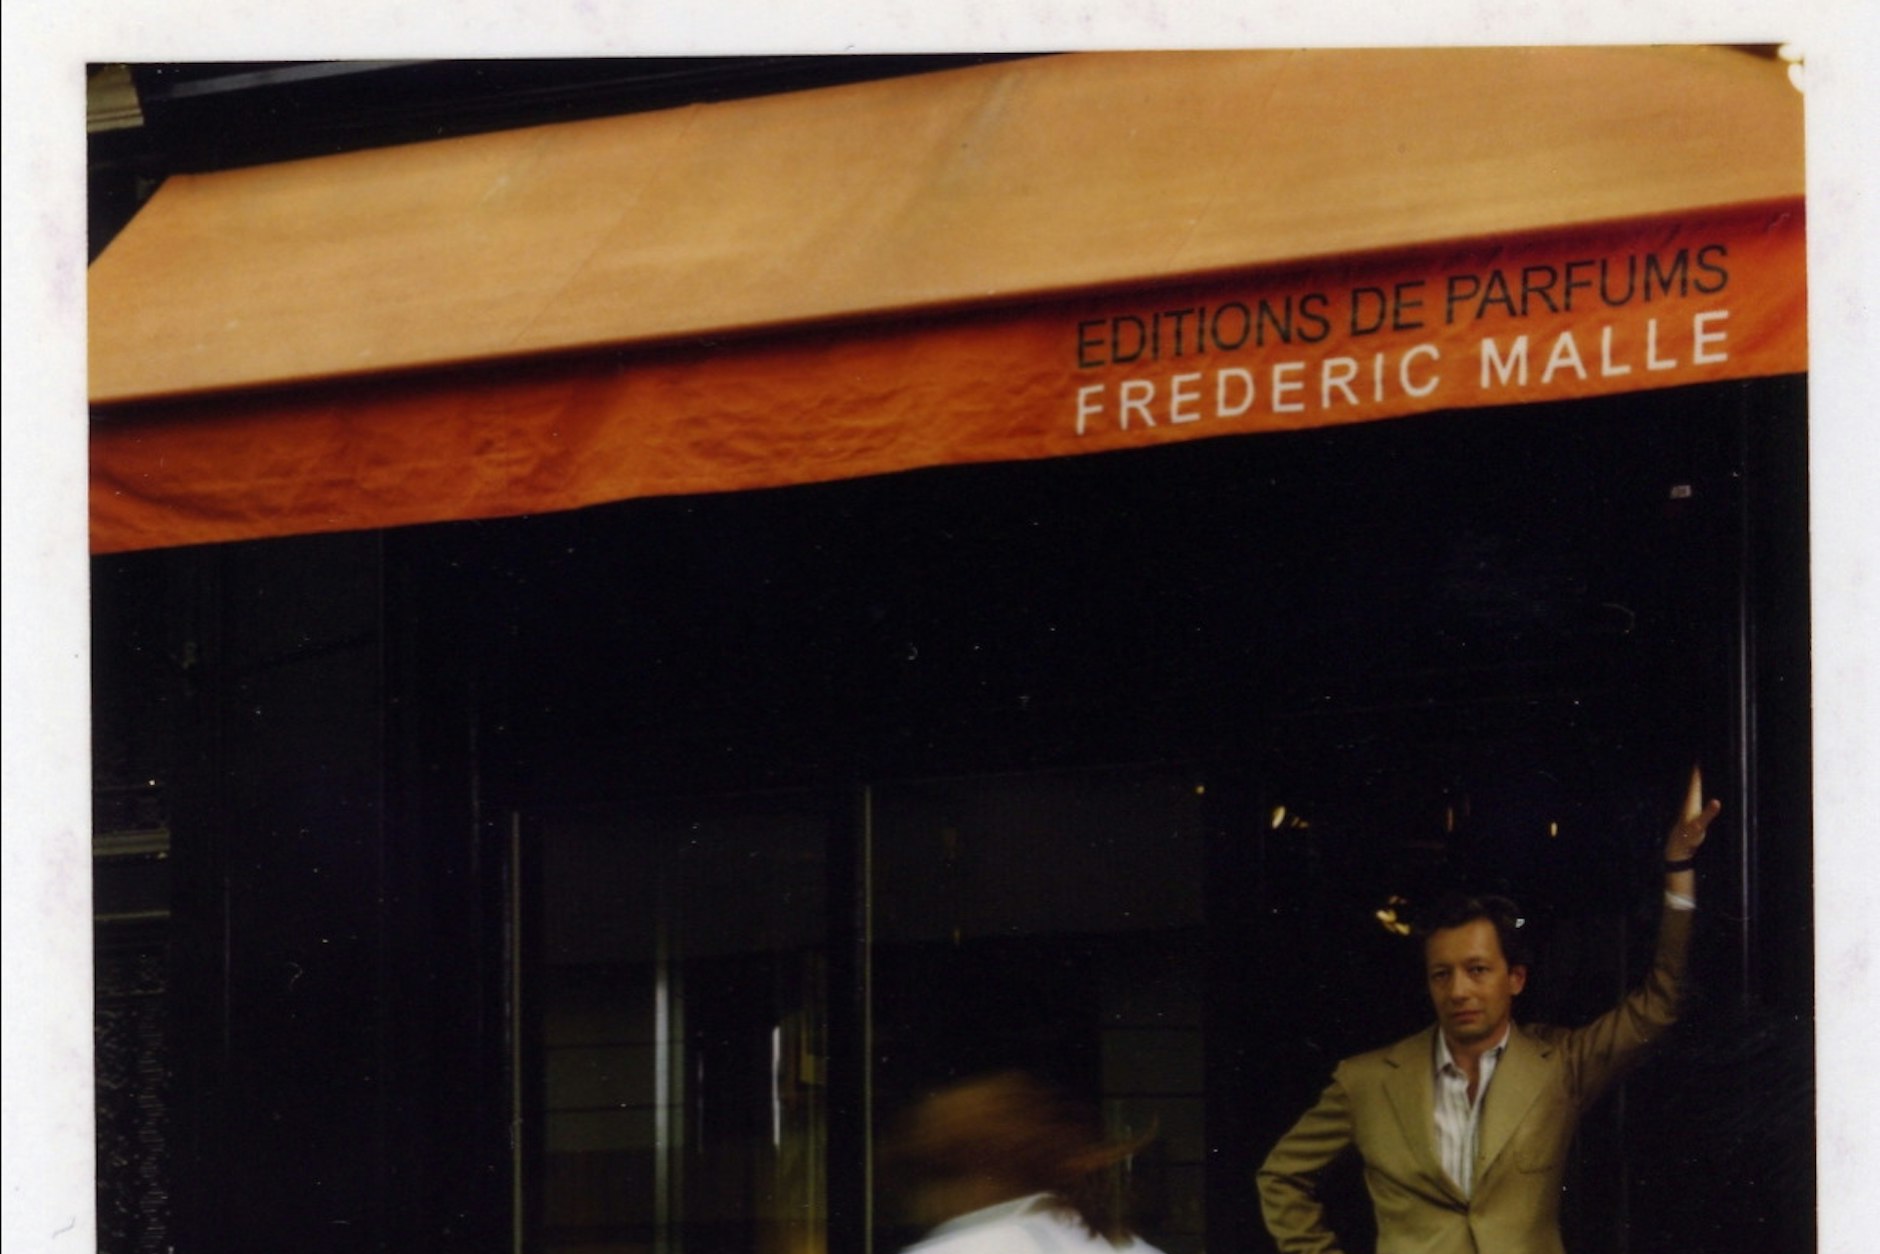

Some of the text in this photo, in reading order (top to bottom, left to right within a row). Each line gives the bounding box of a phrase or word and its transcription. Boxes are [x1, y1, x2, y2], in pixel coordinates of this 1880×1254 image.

[1077, 243, 1731, 369] EDITIONS DE PARFUMS
[1074, 310, 1731, 436] FREDERIC MALLE
